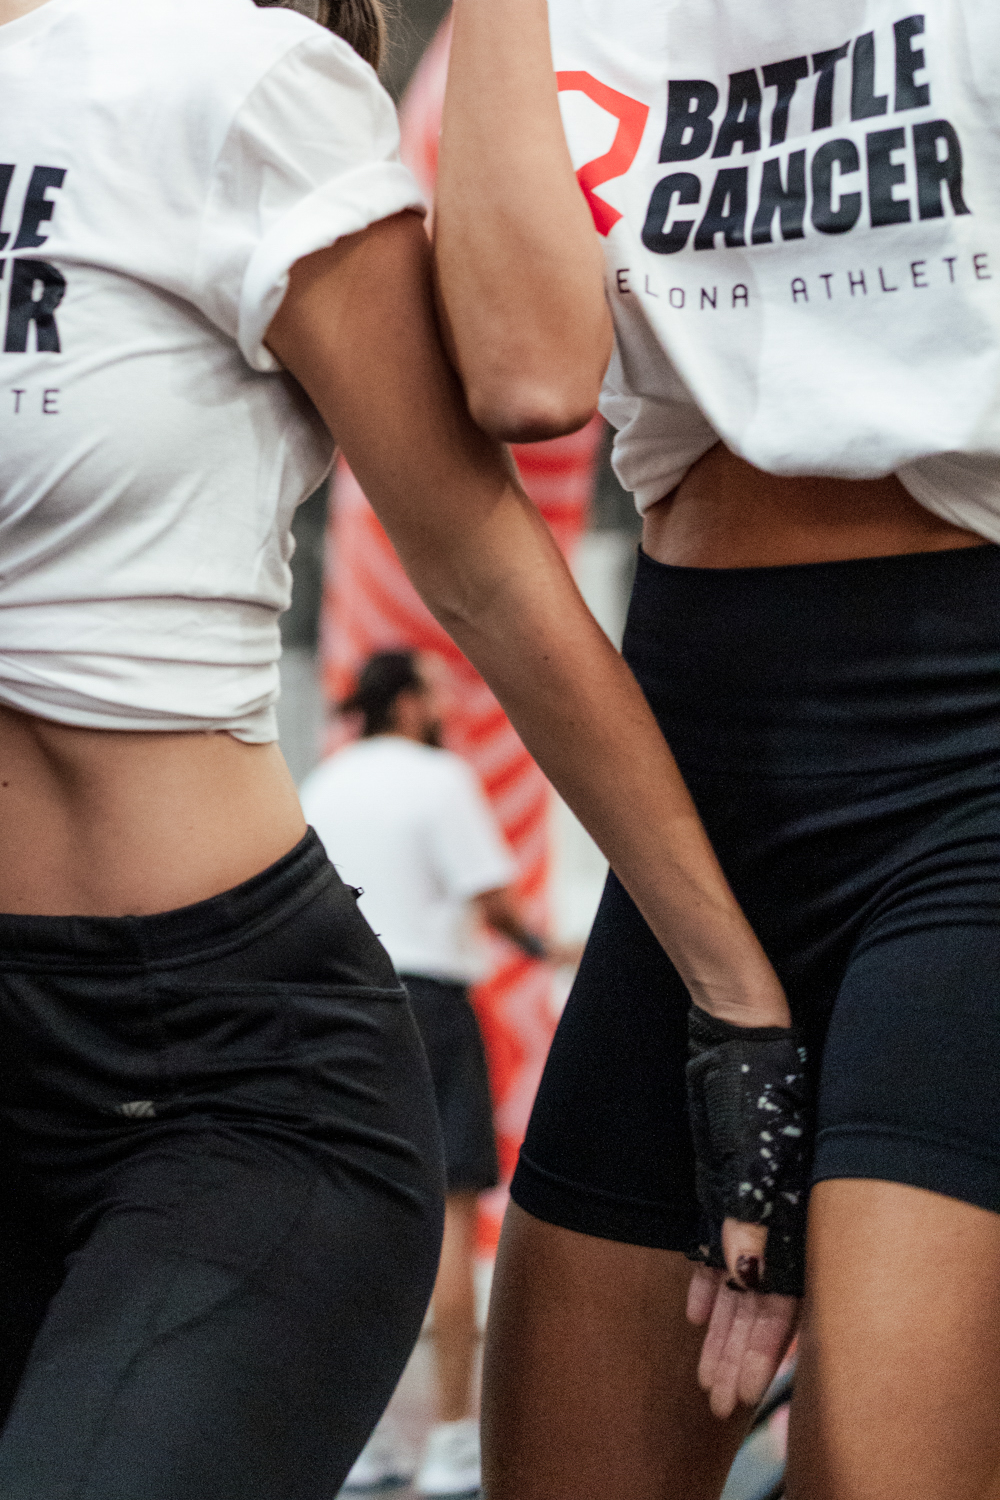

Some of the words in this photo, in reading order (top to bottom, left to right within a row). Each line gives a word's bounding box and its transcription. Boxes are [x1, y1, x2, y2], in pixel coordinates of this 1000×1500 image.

[658, 14, 931, 164] BATTLE
[641, 119, 973, 255] CANCER
[616, 268, 749, 310] ELONA
[791, 253, 993, 304] ATHLETE
